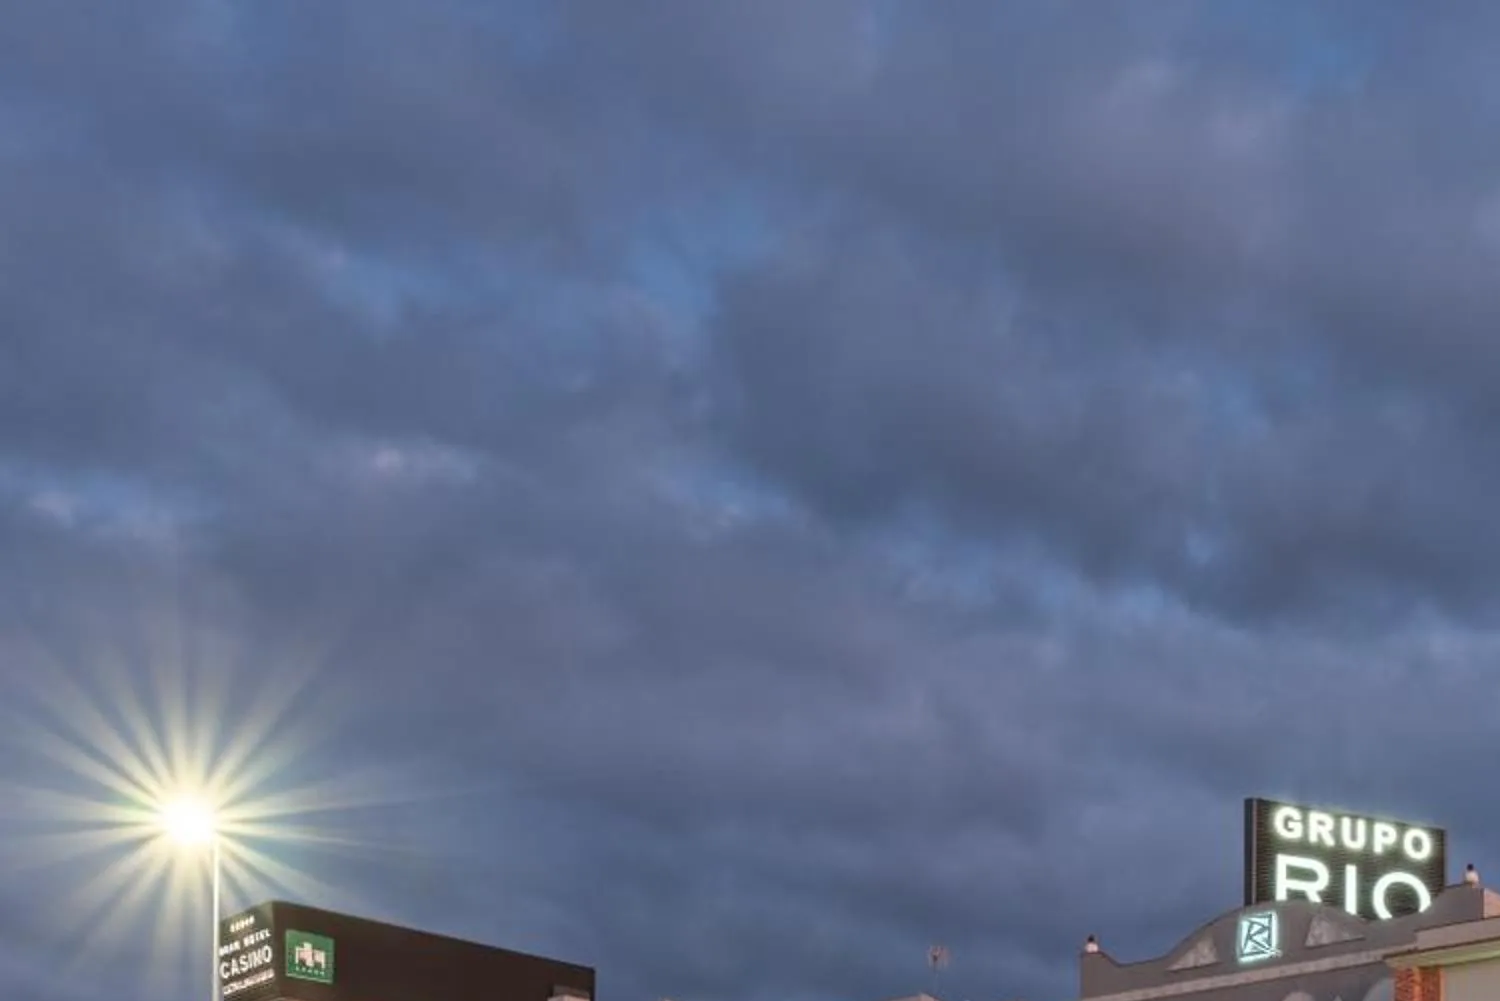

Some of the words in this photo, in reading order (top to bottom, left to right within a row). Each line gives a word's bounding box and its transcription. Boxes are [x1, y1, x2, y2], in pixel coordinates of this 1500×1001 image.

[1275, 805, 1432, 861] GRUPO
[1275, 853, 1432, 919] RIO
[243, 928, 271, 947] HOTEL
[219, 945, 273, 979] CASINO
